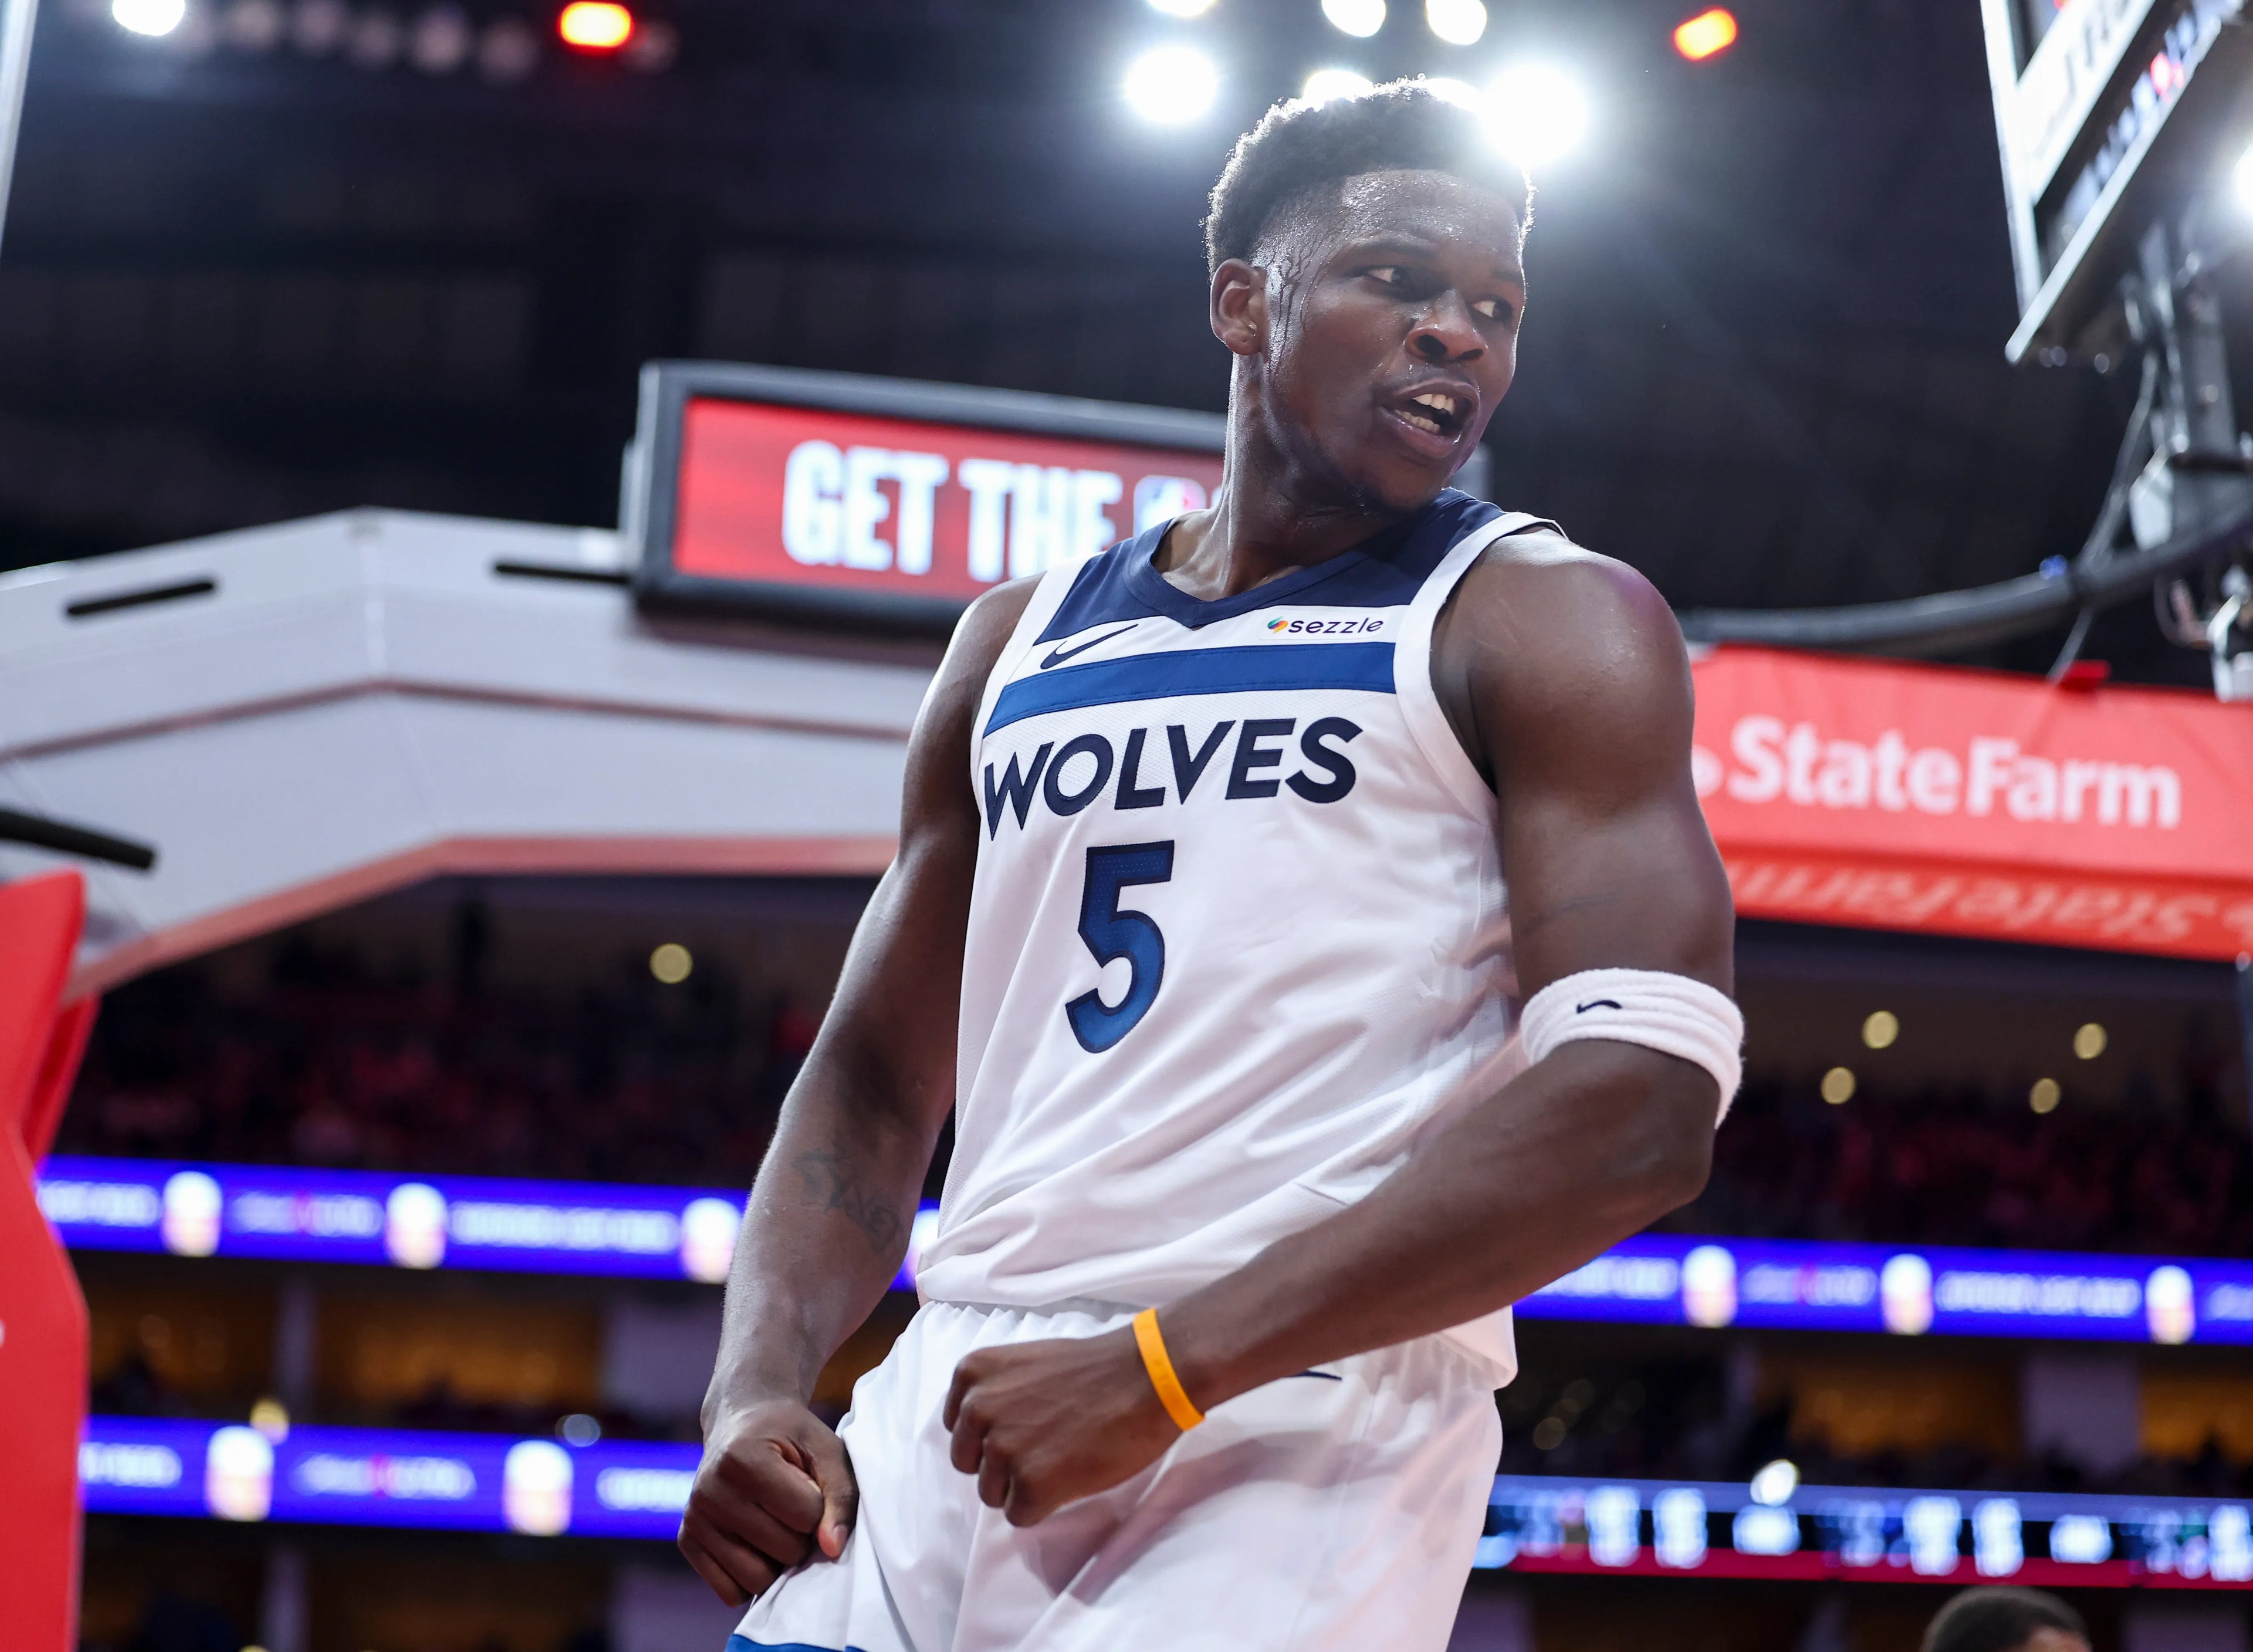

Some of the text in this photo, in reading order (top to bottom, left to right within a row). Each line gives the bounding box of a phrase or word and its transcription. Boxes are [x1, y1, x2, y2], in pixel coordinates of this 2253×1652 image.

[784, 441, 1122, 581] GET THE
[1288, 617, 1383, 634] sezzle
[984, 717, 1362, 840] WOLVES
[1065, 839, 1174, 1054] 5
